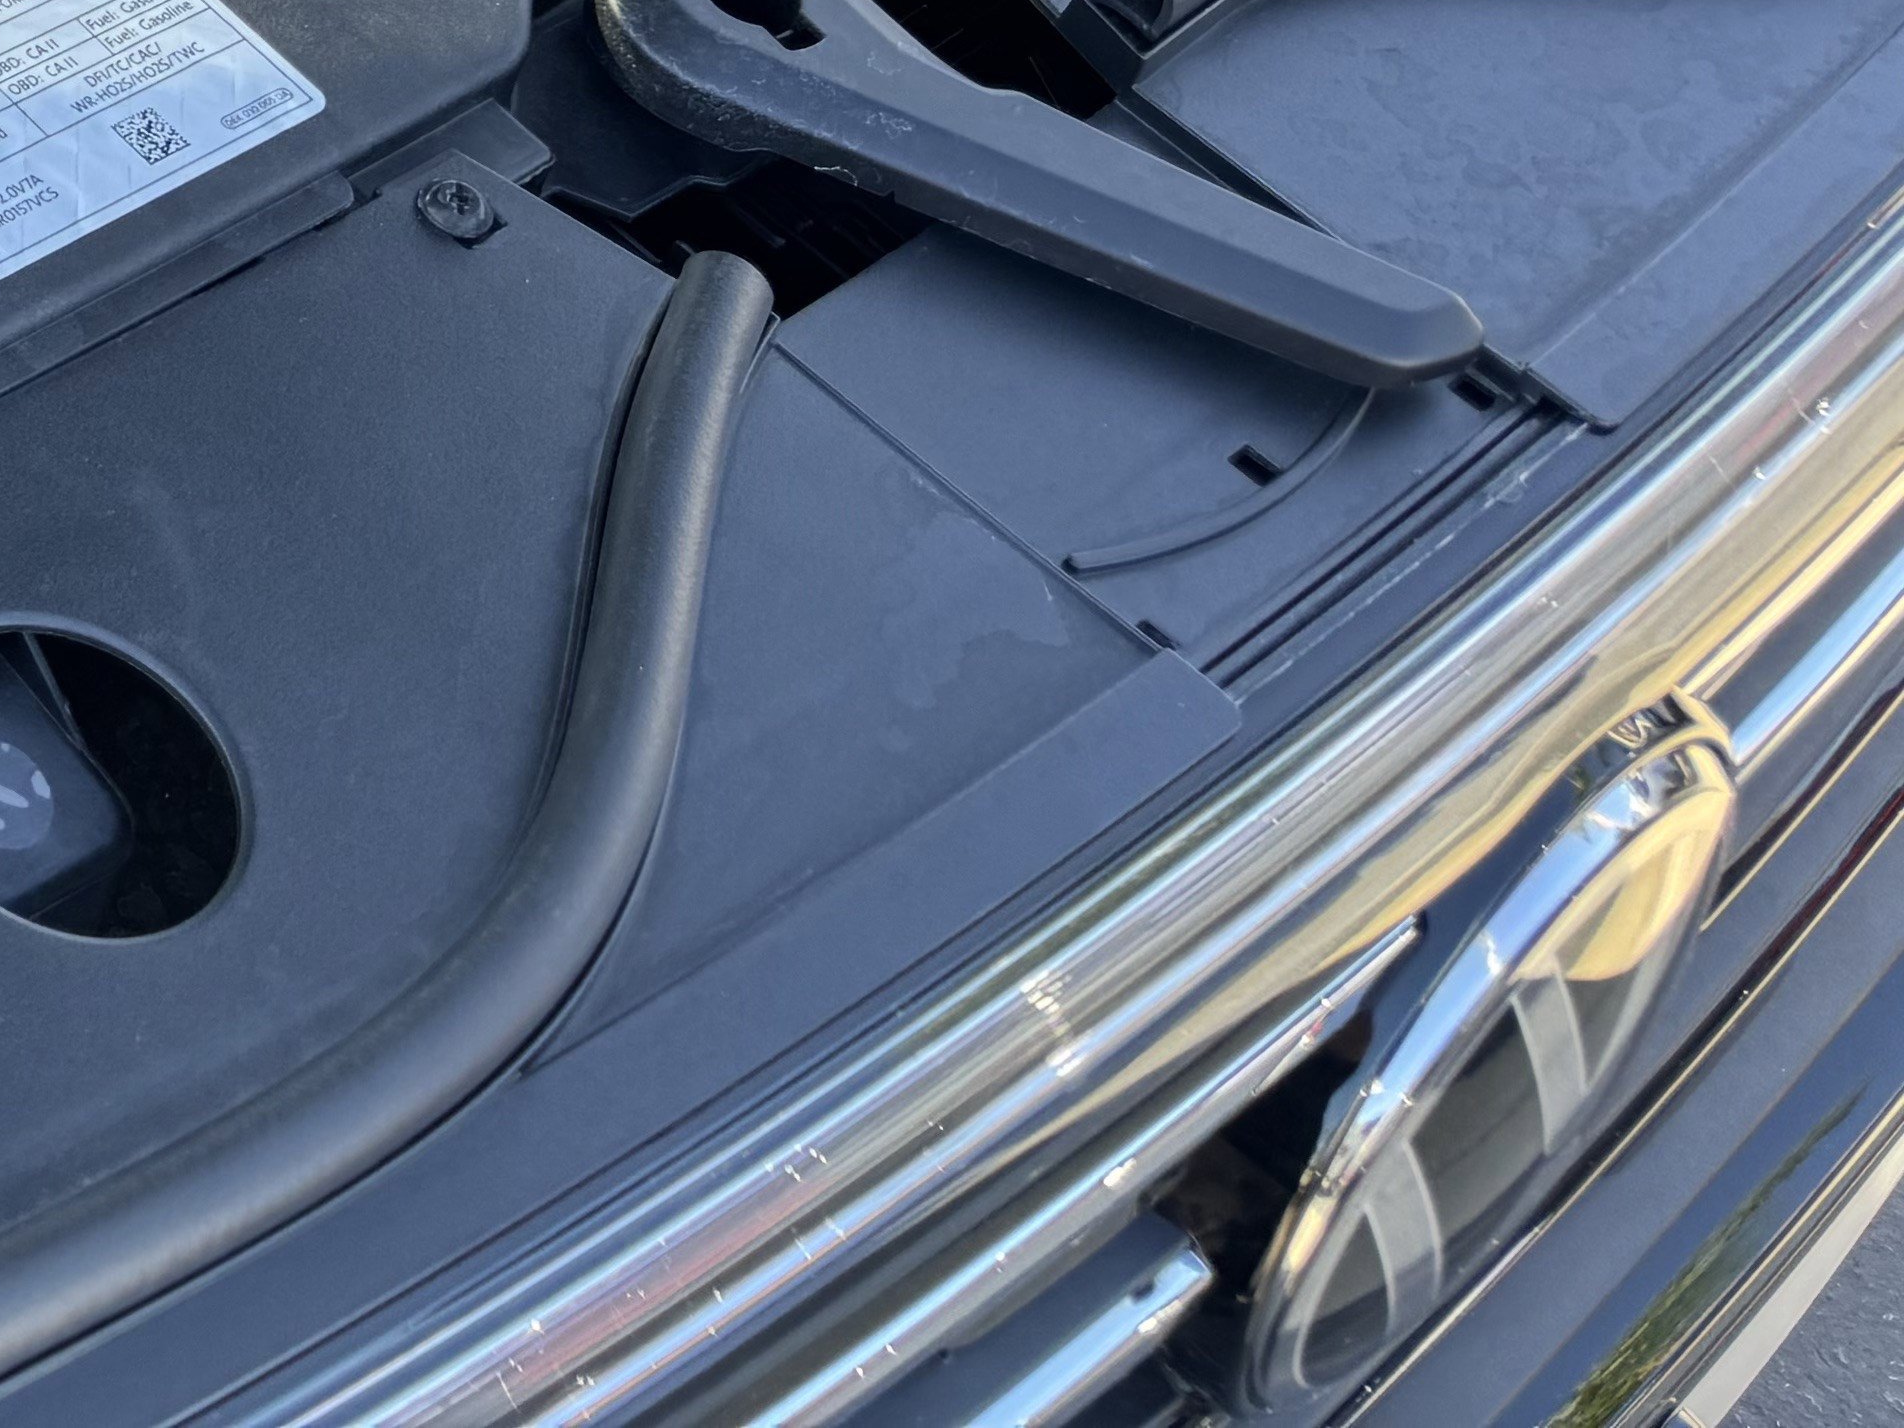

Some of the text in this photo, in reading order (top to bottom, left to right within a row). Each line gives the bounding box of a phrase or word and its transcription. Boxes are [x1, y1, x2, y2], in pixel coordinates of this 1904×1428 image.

[84, 10, 120, 31] Fuel:
[103, 0, 194, 49] Fuel: Gasoline
[25, 44, 49, 60] CA
[82, 41, 162, 88] DFI/TC/CAC/
[7, 74, 45, 96] OBD:
